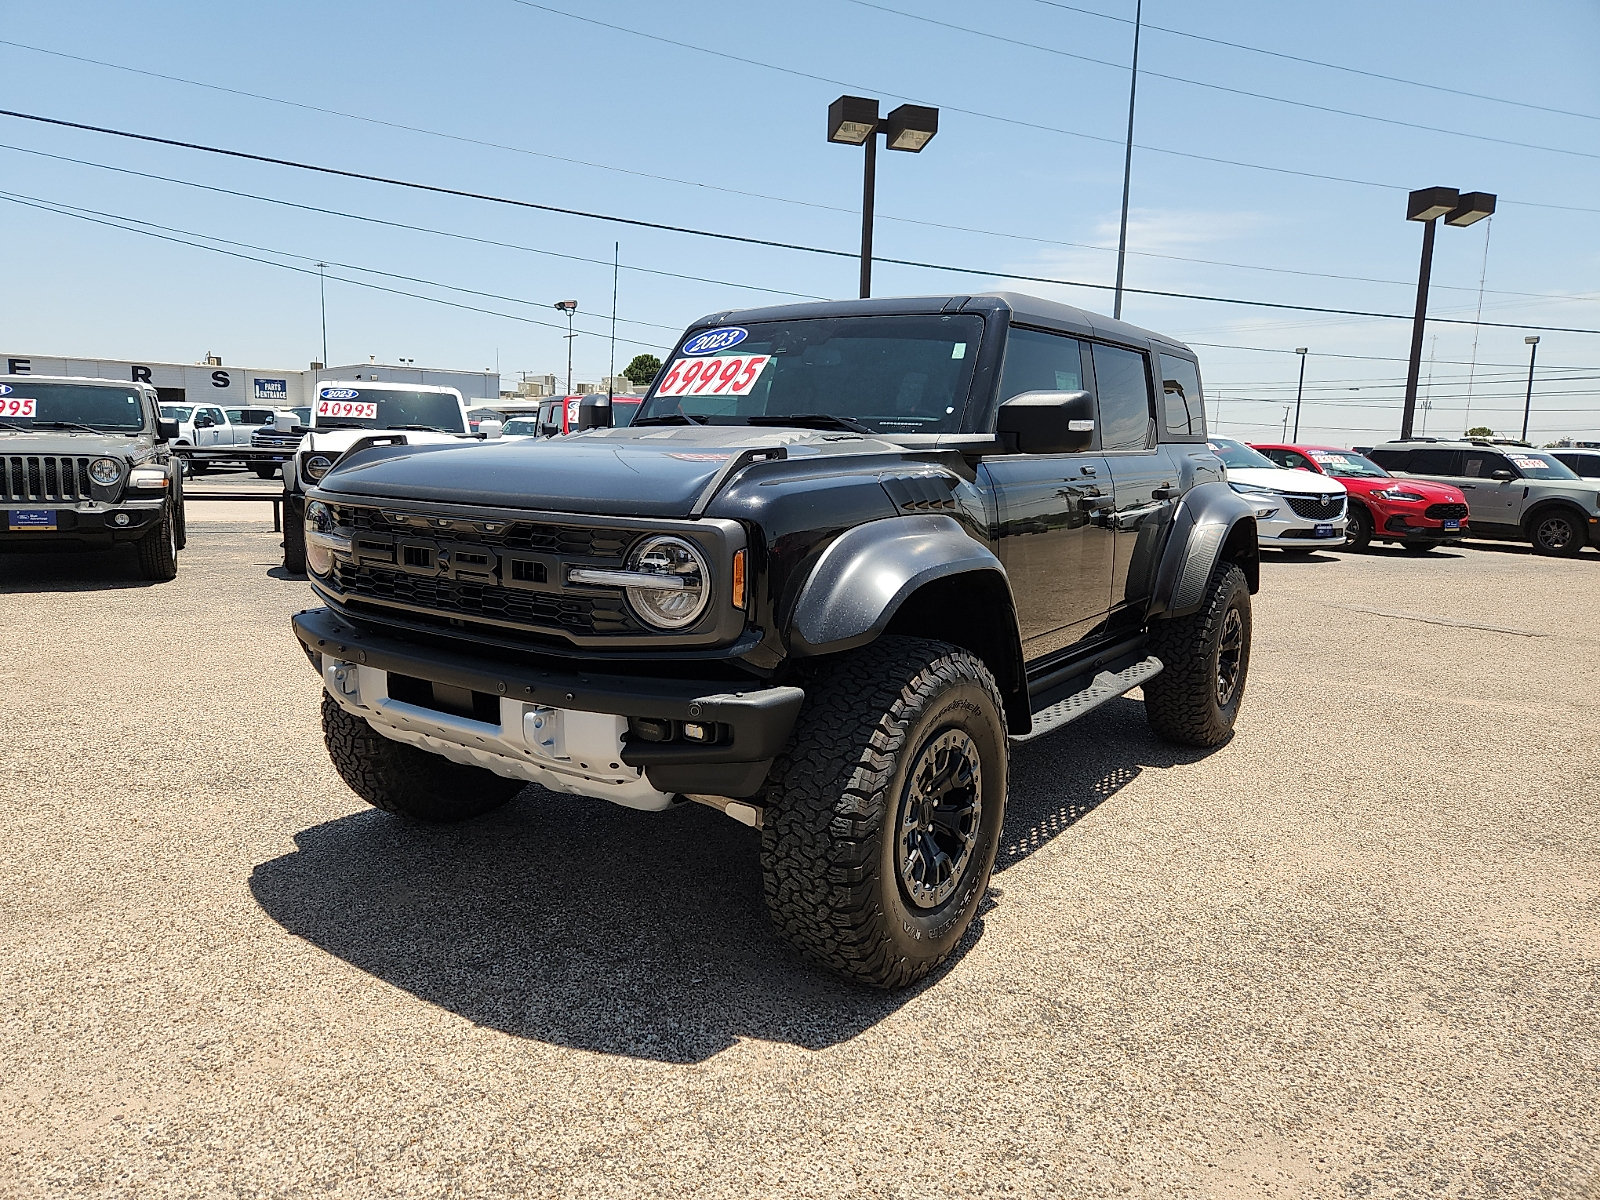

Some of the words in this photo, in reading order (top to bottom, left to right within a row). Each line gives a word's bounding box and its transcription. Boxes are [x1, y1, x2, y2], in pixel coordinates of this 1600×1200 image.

[689, 330, 740, 353] 2023
[659, 357, 767, 394] 69995
[260, 390, 287, 399] ENTRANCE
[264, 382, 281, 391] PARTS
[319, 401, 375, 417] 40995
[351, 530, 563, 594] FORD
